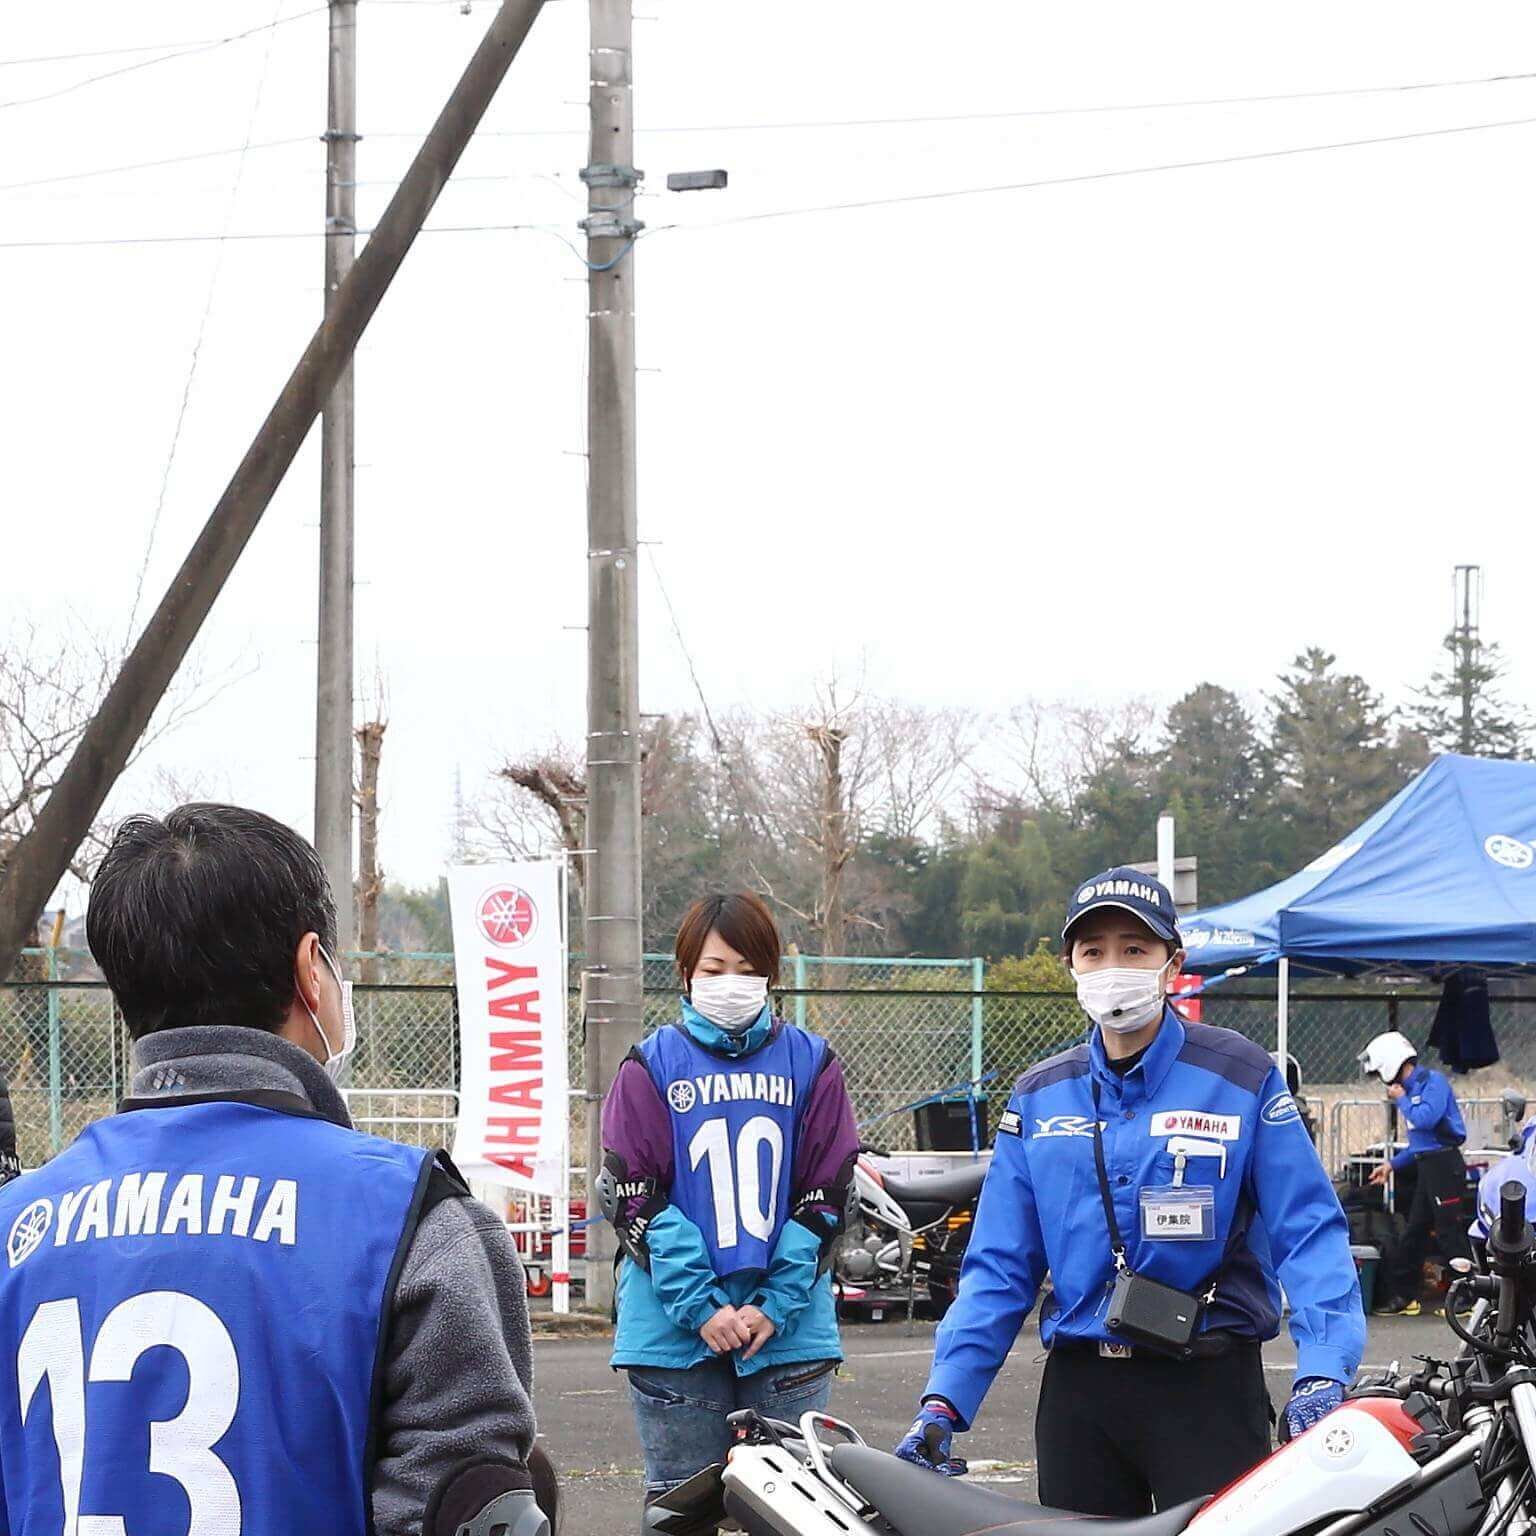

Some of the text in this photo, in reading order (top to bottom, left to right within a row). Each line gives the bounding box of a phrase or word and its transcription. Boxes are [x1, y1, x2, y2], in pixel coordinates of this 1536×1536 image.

[1096, 880, 1161, 906] YAMAHA
[1180, 1118, 1229, 1135] YAMAHA
[689, 1116, 784, 1249] 10
[54, 1171, 297, 1246] YAMAHA
